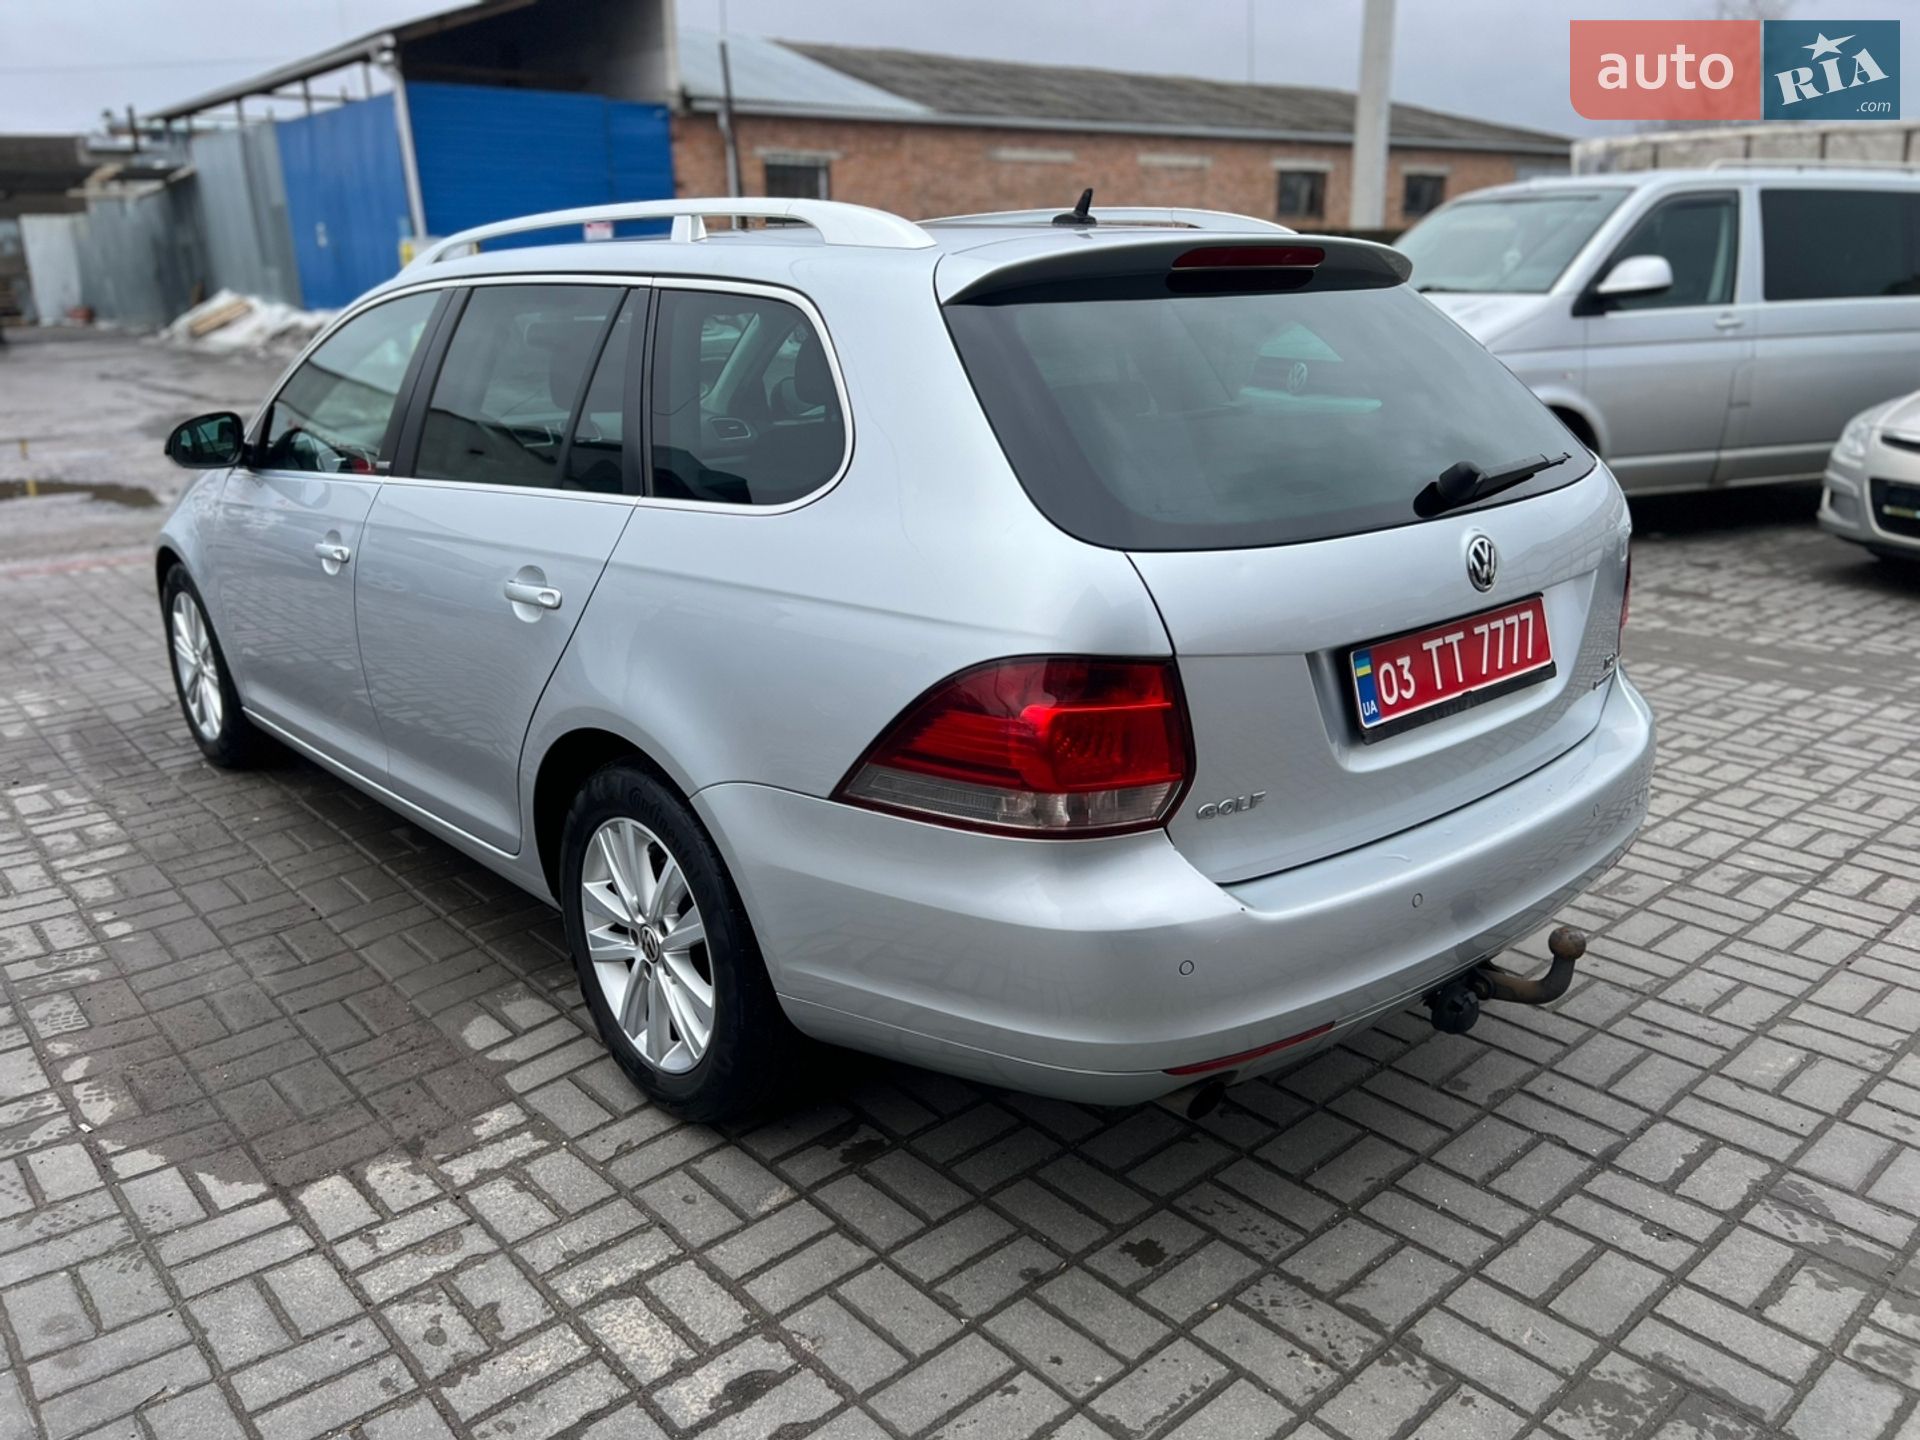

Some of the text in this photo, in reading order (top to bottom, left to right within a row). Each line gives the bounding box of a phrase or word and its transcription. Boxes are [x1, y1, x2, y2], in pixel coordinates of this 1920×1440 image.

[1378, 655, 1416, 706] 03
[1422, 631, 1465, 691] TT
[1473, 609, 1534, 676] 7777
[1362, 699, 1379, 717] UA
[1196, 791, 1267, 820] GOLF
